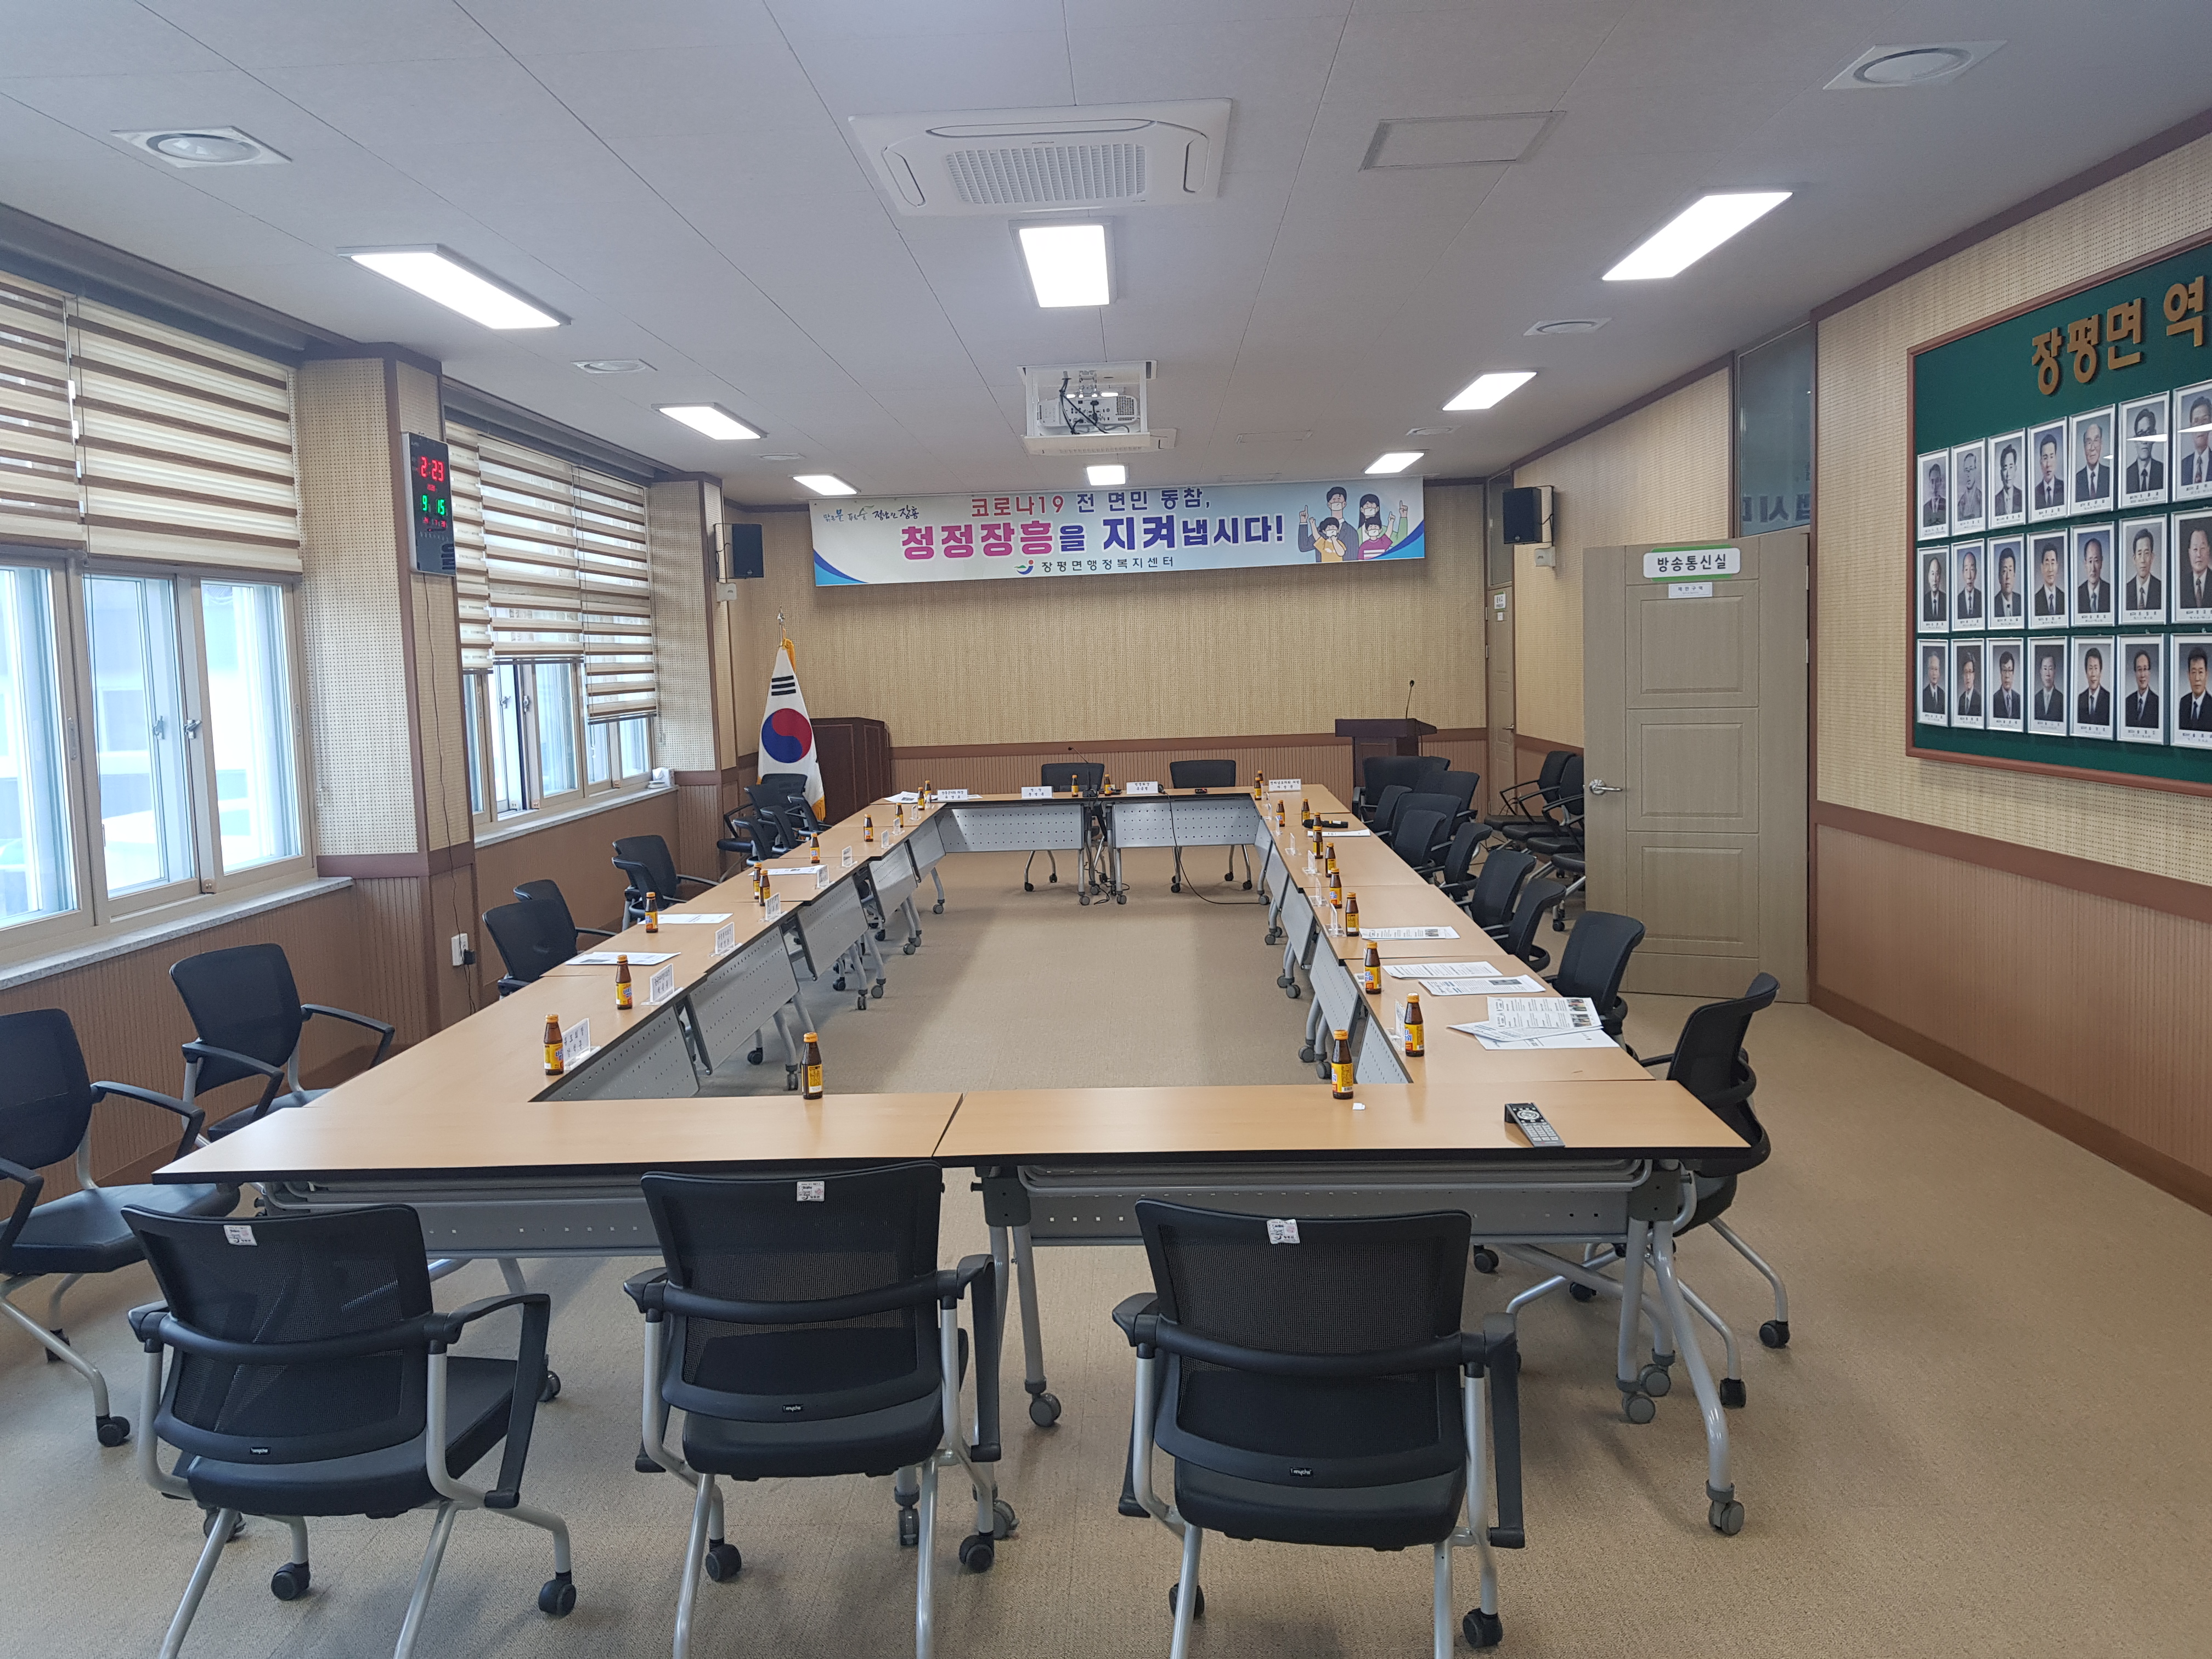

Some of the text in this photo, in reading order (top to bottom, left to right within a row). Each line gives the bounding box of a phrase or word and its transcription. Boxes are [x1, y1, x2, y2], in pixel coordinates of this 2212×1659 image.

[2032, 275, 2205, 396] 장평면 역
[971, 487, 1211, 517] 코로나19 전 면민 동참,
[901, 519, 1086, 560] 청정장흥을
[1041, 556, 1173, 573] 장평면행정복지센터
[1657, 553, 1727, 572] 방송통신실
